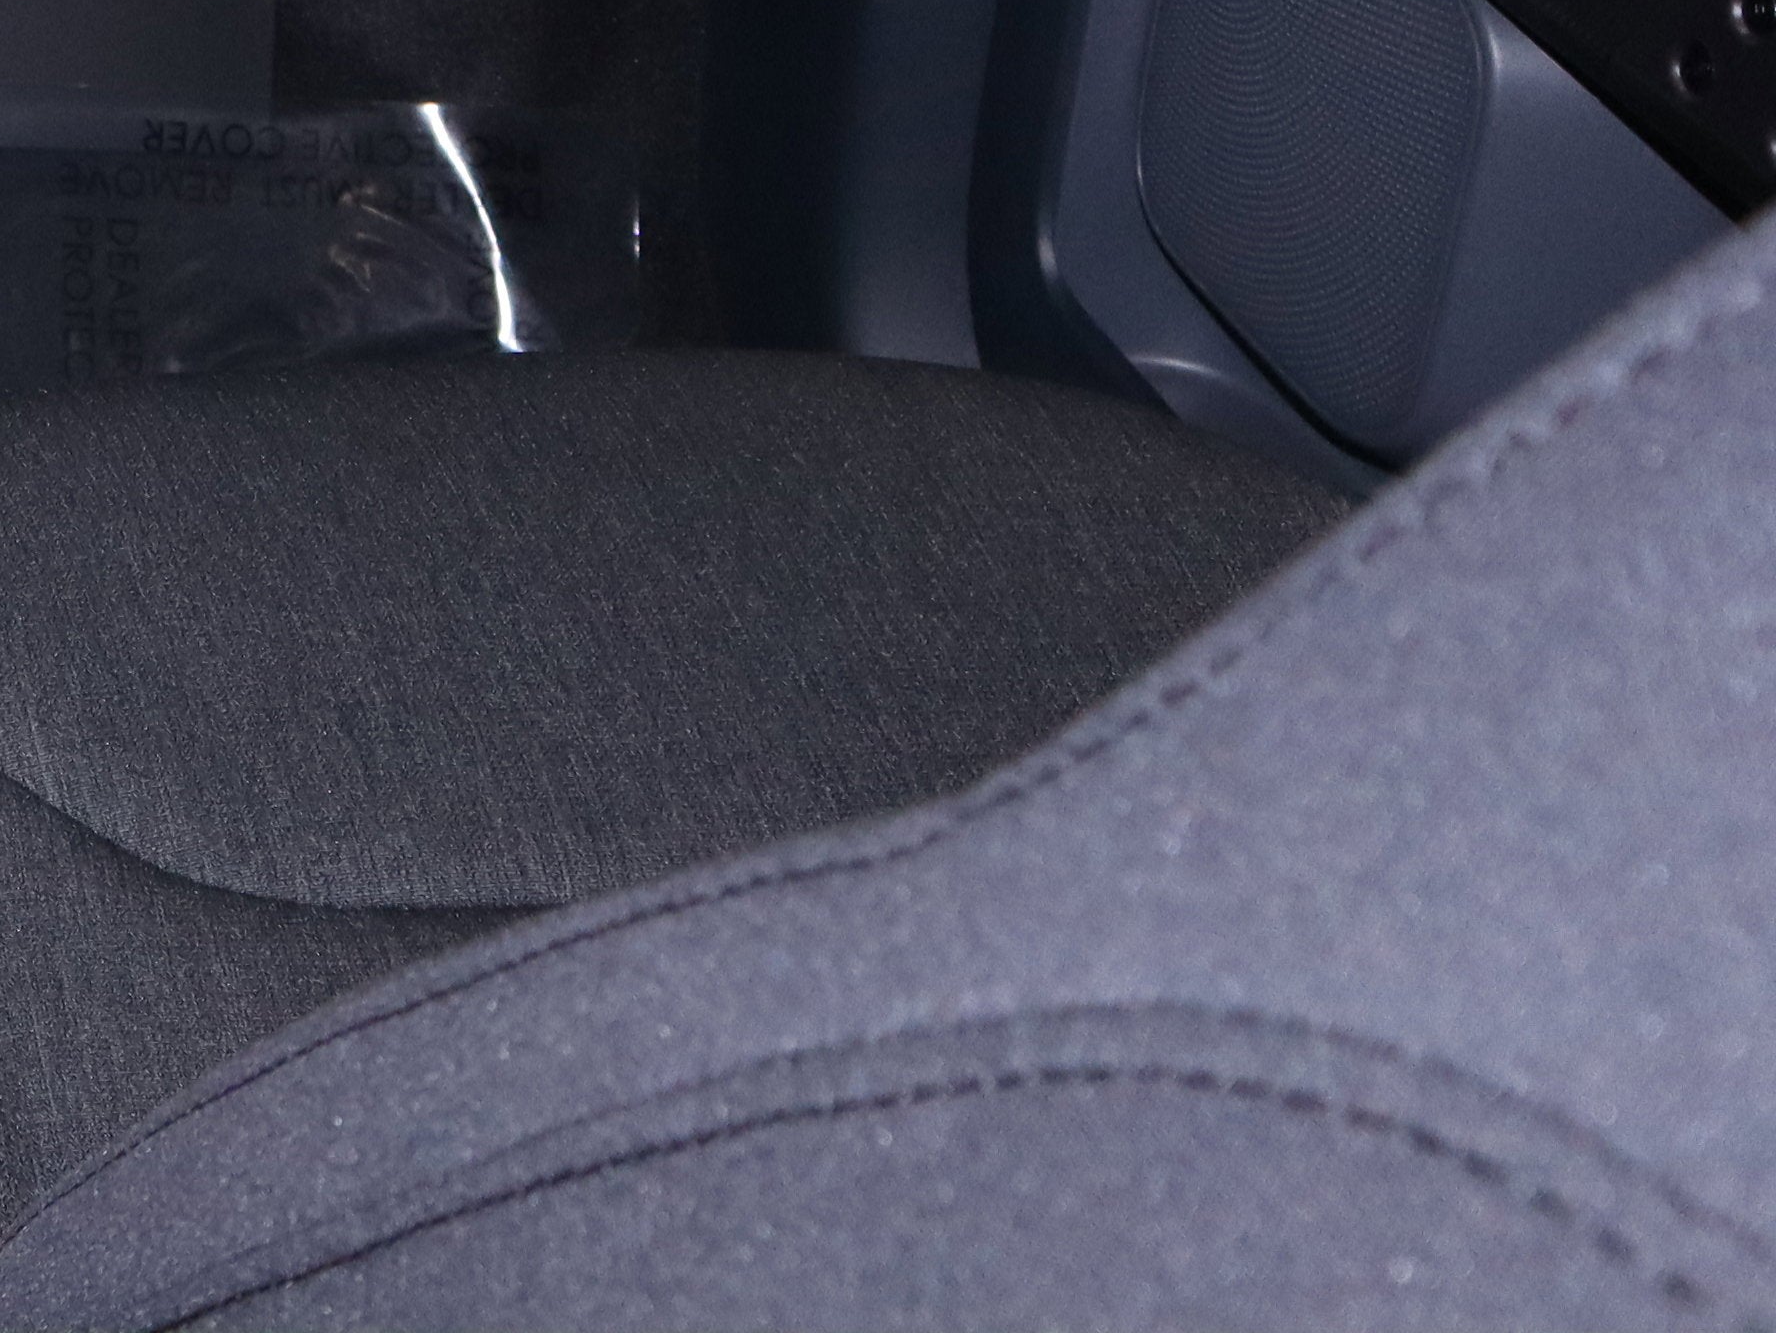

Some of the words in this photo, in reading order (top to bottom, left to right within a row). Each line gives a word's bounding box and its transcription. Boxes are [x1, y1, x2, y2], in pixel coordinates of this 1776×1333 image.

[141, 118, 287, 162] COVER
[300, 126, 542, 173] PROECTIVE
[58, 162, 234, 203] REMOVE
[396, 180, 542, 221] DELER
[106, 218, 143, 376] DEALER
